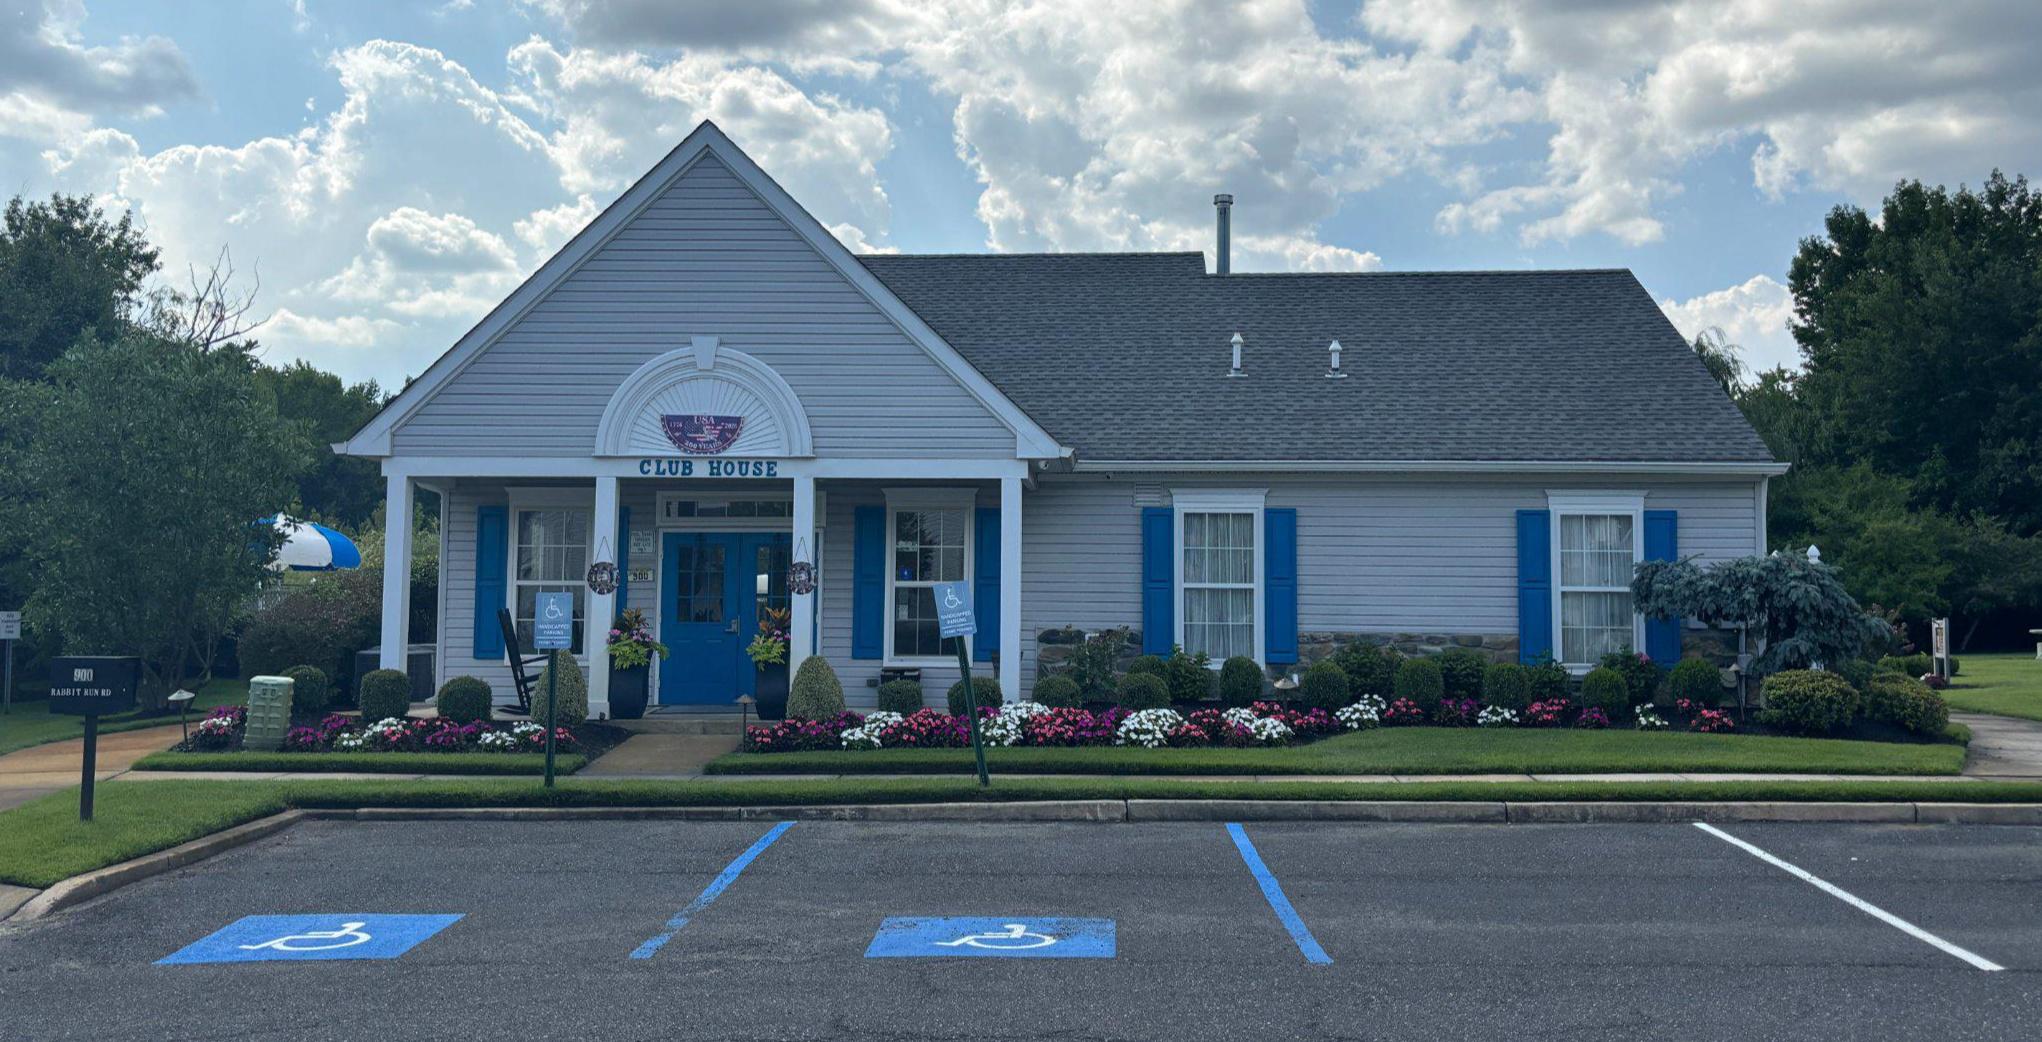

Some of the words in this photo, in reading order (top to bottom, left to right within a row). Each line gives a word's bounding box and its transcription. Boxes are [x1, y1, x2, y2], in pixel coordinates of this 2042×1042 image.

[694, 416, 715, 424] USA
[640, 459, 693, 476] CLUB
[708, 460, 778, 477] HOUSE
[632, 572, 649, 581] 900
[940, 610, 972, 619] HANDICAPPED
[947, 617, 967, 625] PARKING
[73, 668, 94, 682] 900
[50, 688, 81, 696] RABBIT
[83, 688, 99, 696] RUN
[101, 688, 112, 696] RD
